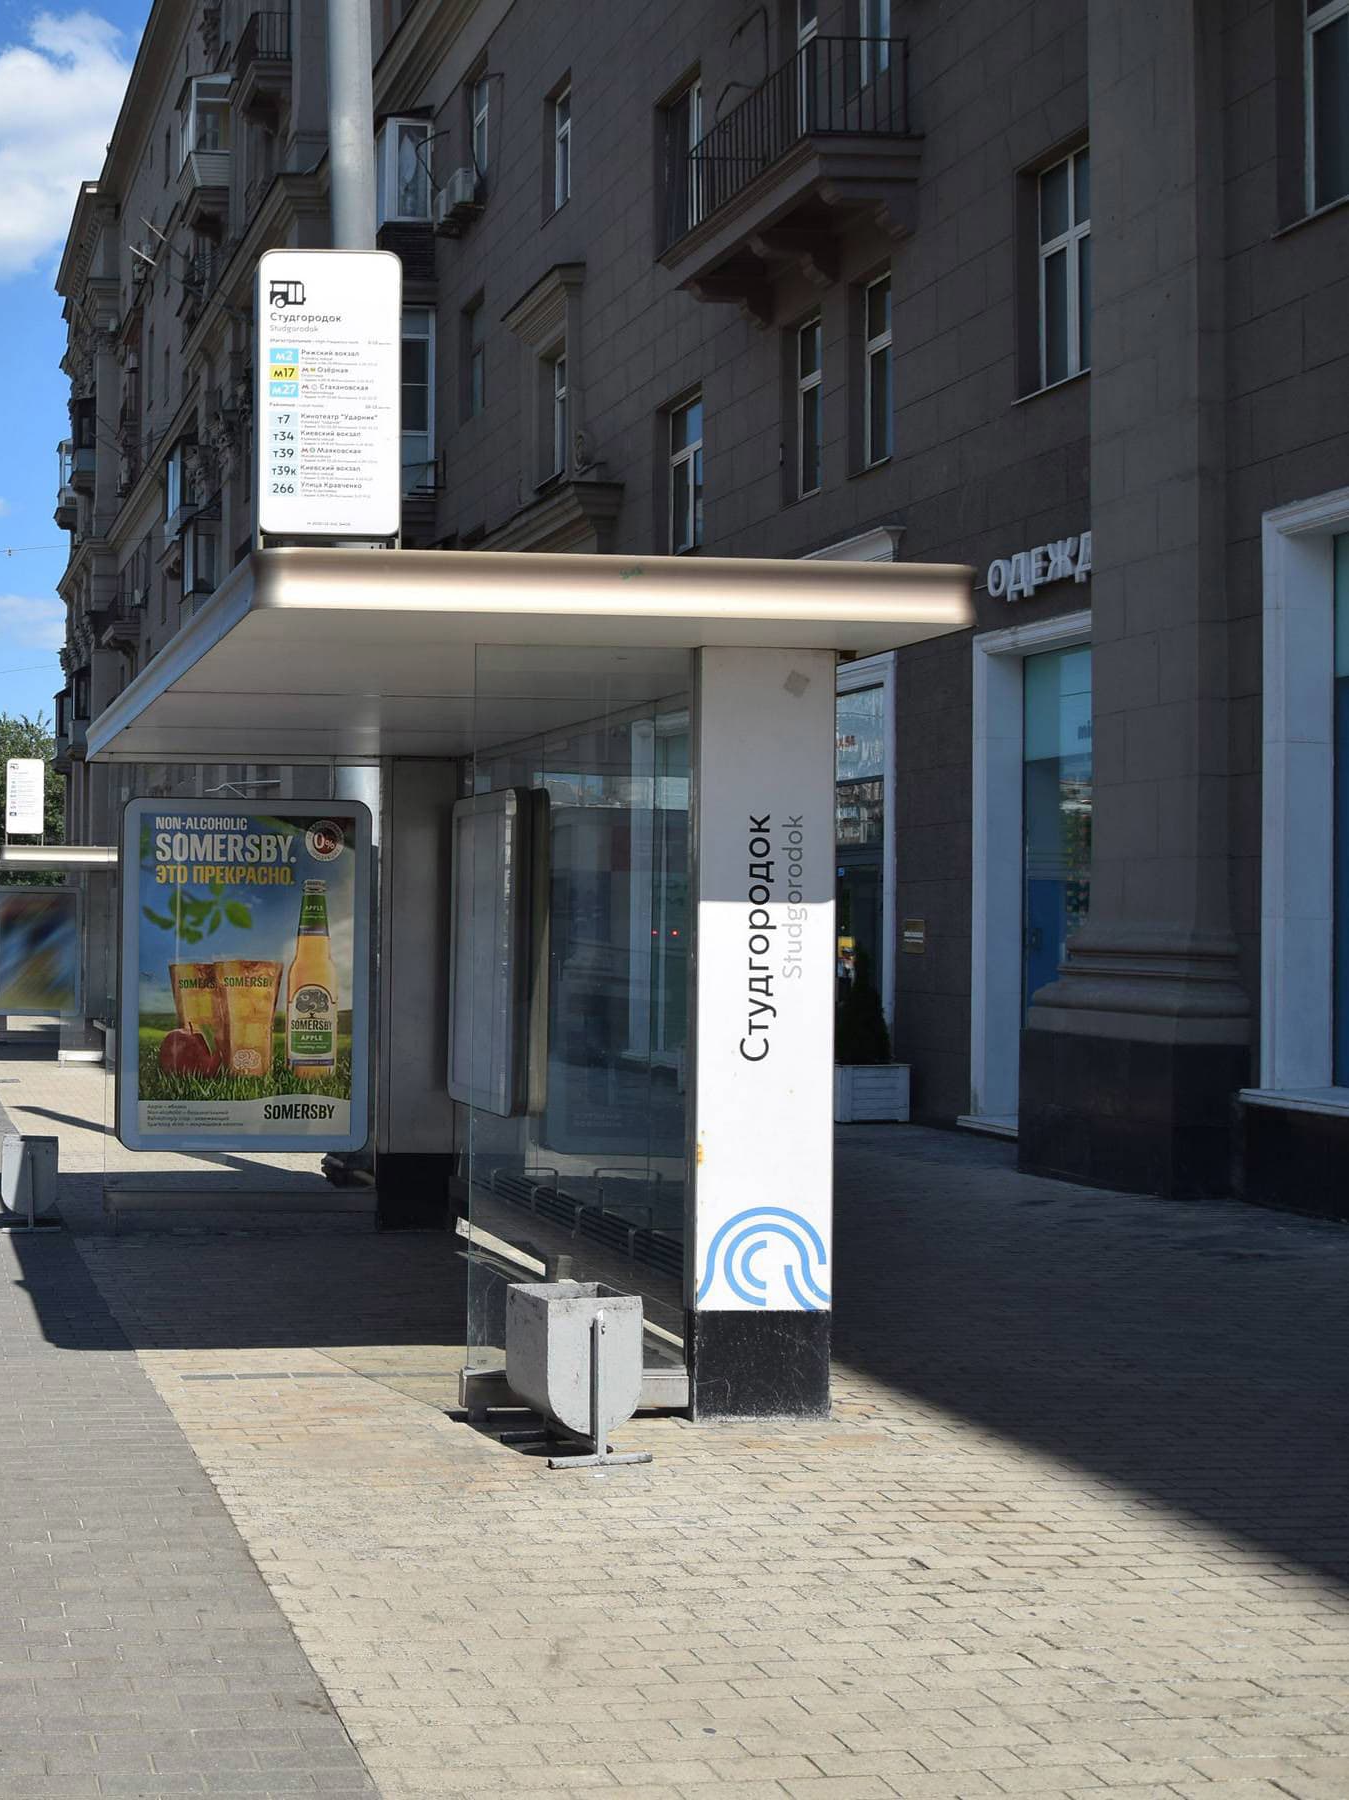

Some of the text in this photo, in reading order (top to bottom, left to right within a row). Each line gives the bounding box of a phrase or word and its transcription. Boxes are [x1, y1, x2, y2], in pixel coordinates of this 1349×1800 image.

[270, 312, 342, 323] Студгородок
[272, 483, 295, 494] 266
[155, 816, 248, 831] NON-ALCOHOLIC
[155, 832, 297, 863] SOMERSBY.
[155, 864, 295, 885] ЭТО ПРЕКРАСНО.
[781, 815, 808, 979] Studgorodok
[739, 813, 777, 1062] Студгородок
[223, 976, 274, 988] SOMERSBY
[290, 1019, 333, 1030] SOMERSBY
[263, 1103, 335, 1120] SOMERSBY
